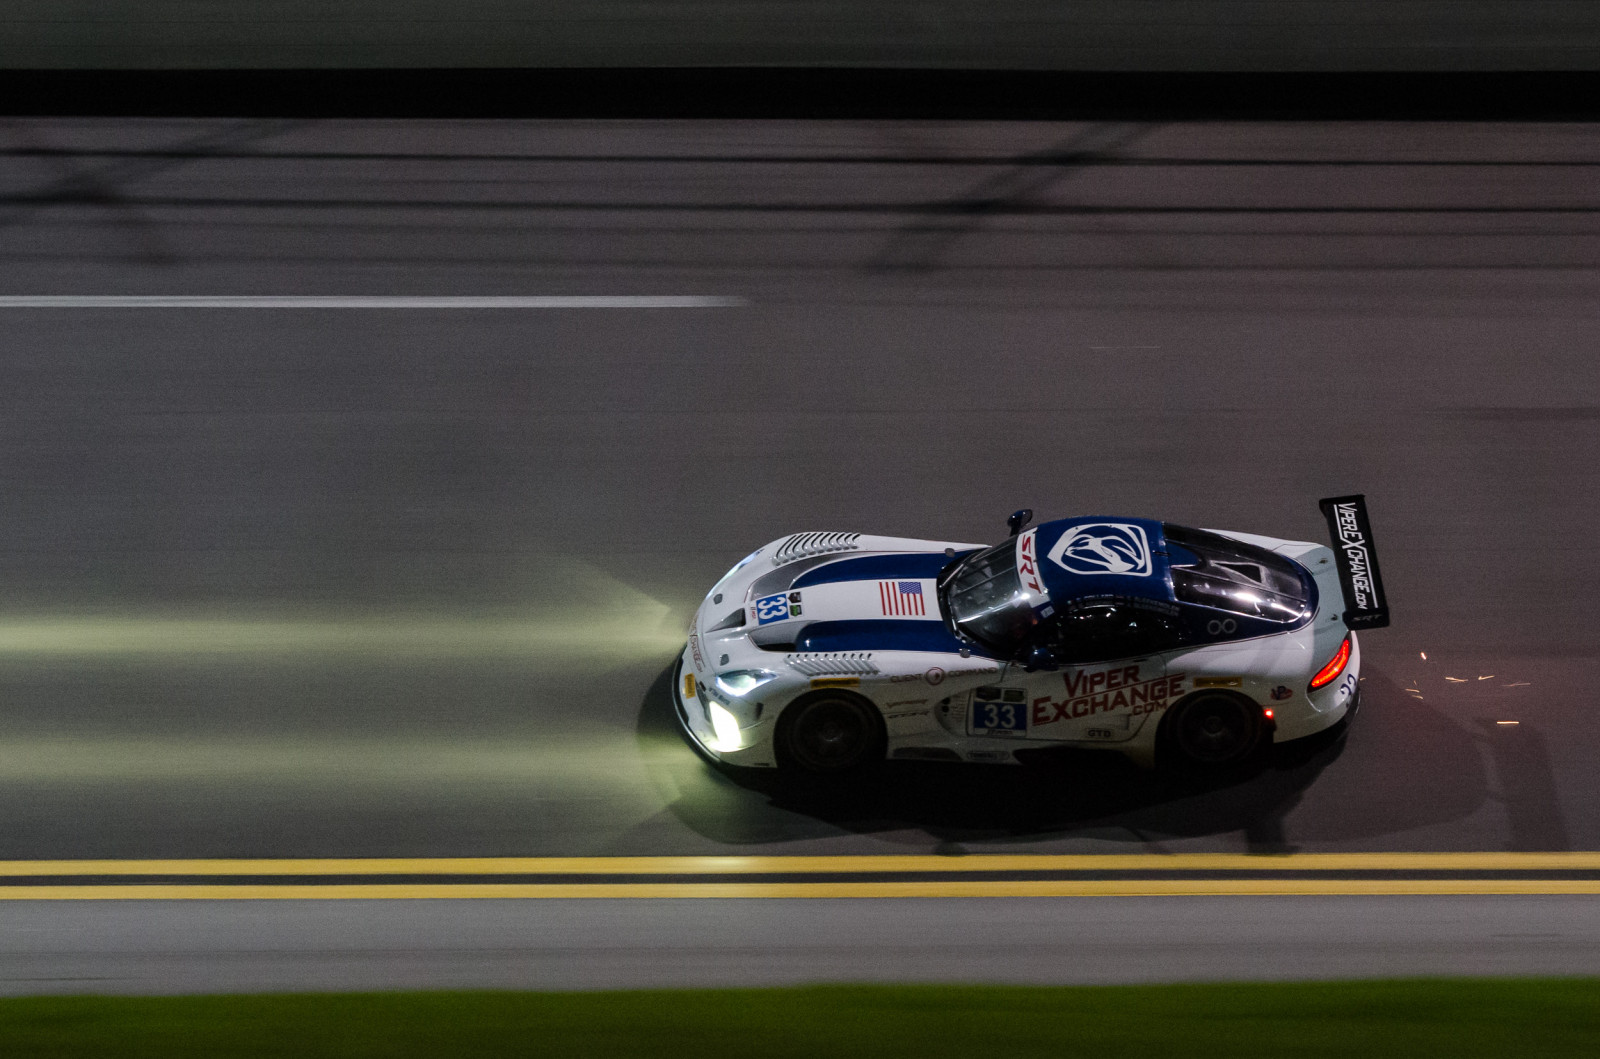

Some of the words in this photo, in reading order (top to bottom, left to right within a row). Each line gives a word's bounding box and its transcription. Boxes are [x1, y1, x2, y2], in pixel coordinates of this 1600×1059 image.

[1020, 534, 1042, 595] SRT
[757, 596, 788, 620] 33
[1063, 665, 1141, 698] VIPER
[984, 704, 1016, 729] 33
[1032, 675, 1186, 727] EXCHANGE
